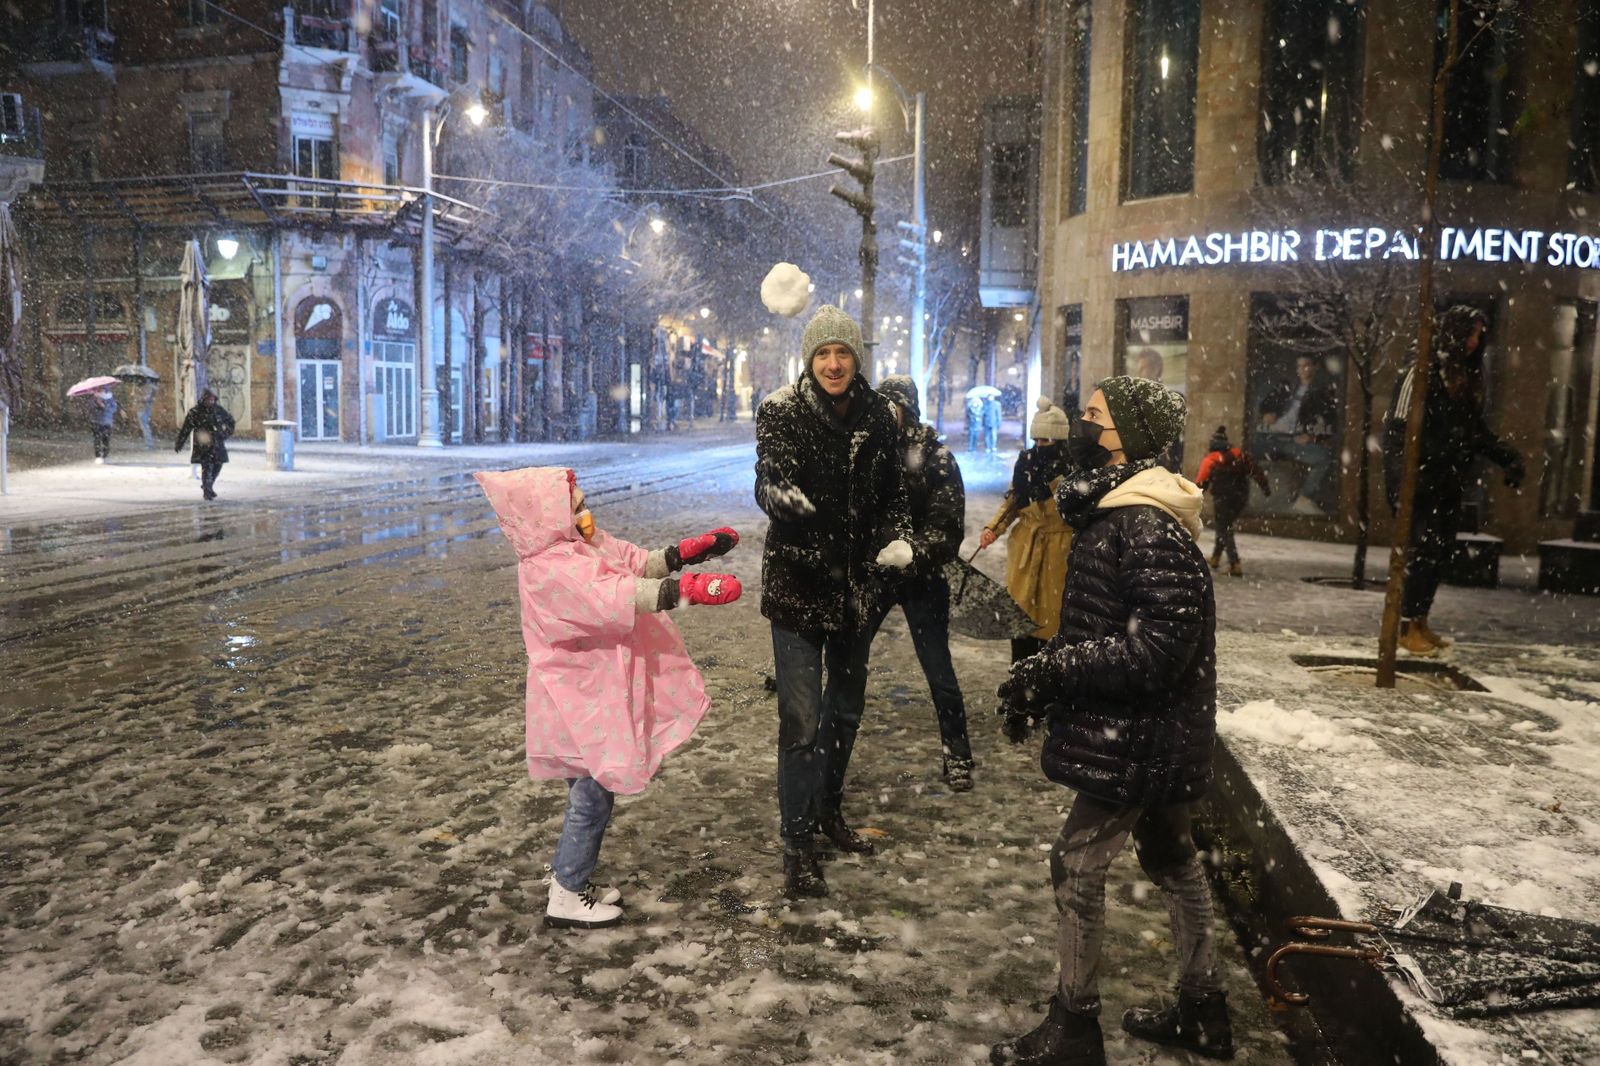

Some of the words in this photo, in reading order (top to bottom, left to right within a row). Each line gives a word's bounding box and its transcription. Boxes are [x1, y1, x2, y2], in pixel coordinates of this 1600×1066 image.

[1112, 230, 1301, 272] HAMASHBIR
[386, 311, 409, 330] Aldo
[1130, 315, 1183, 330] MASHBIR
